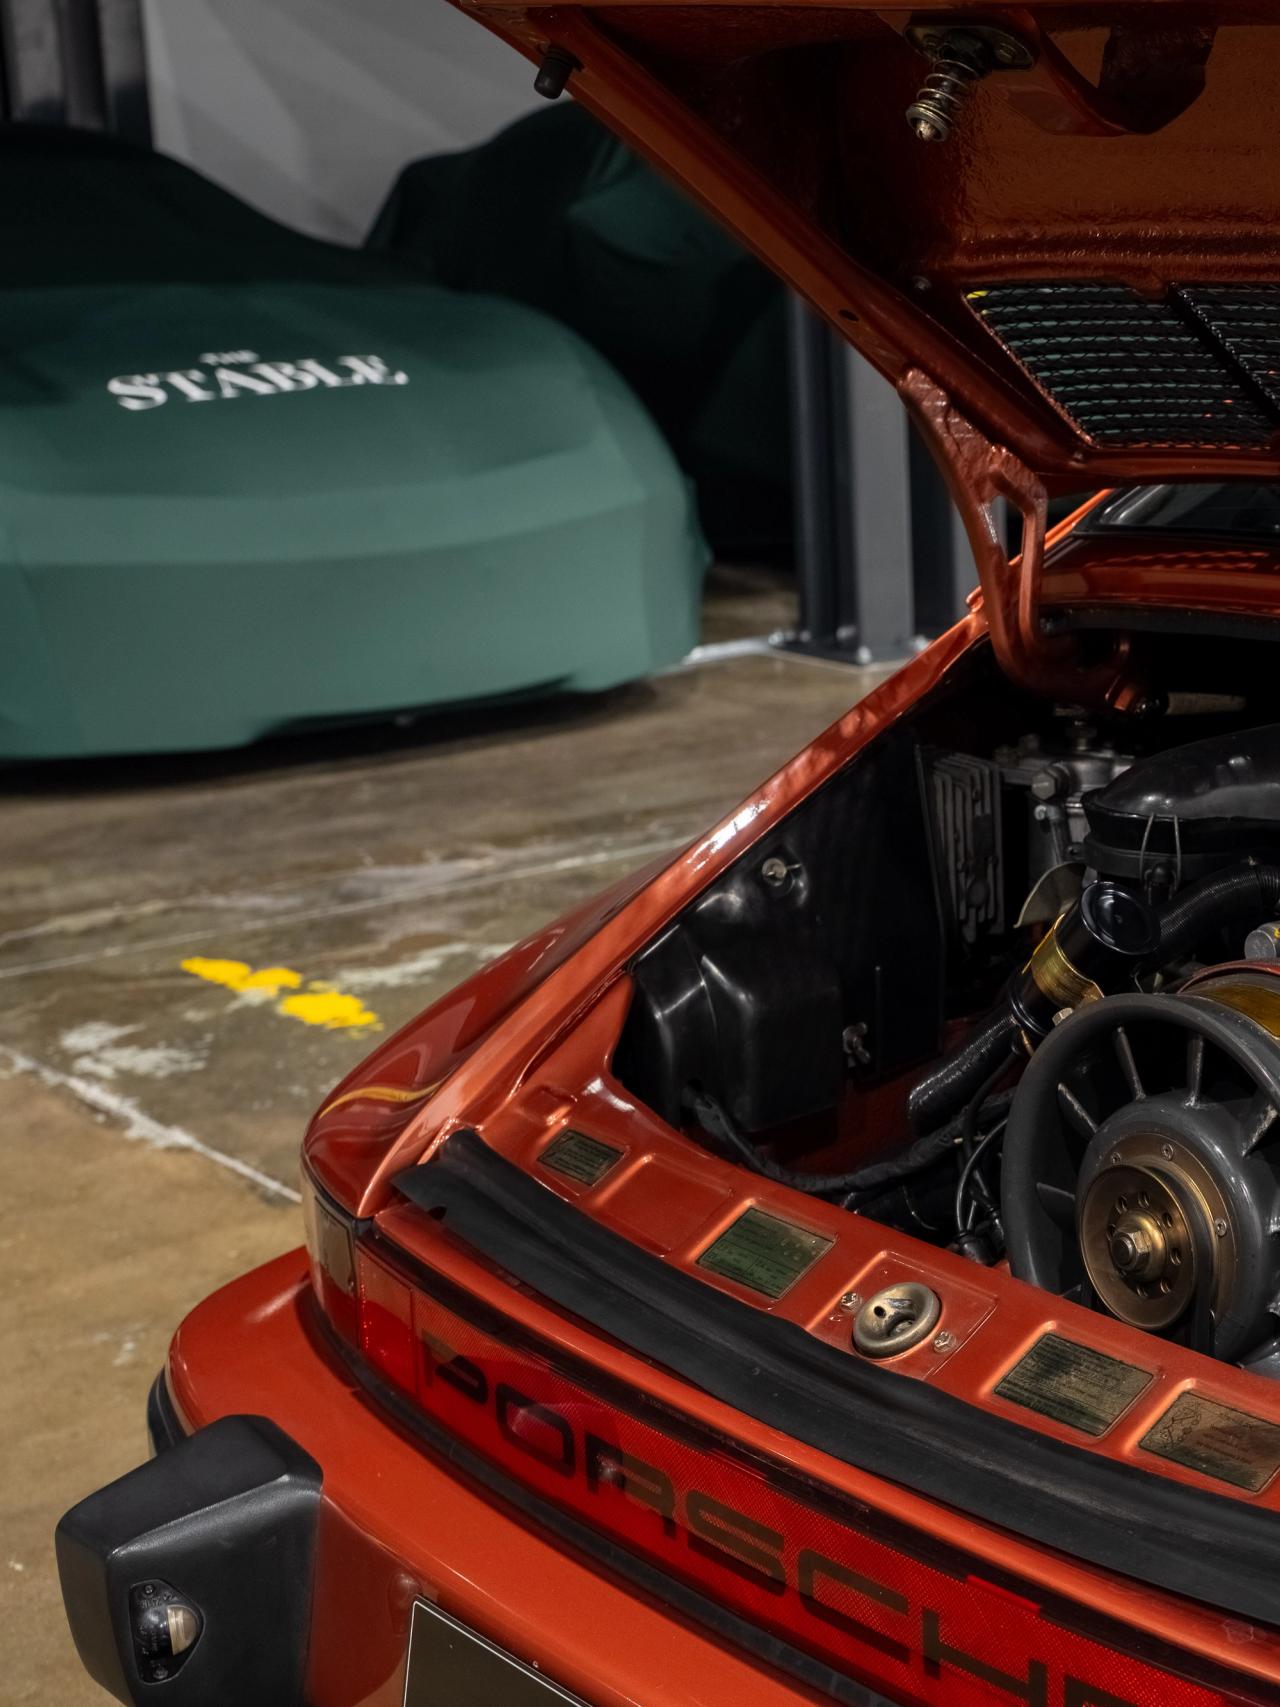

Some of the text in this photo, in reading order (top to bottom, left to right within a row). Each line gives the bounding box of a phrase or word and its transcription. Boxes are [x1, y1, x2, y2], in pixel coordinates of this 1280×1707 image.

[106, 355, 408, 410] STABLE
[199, 350, 260, 366] THE
[421, 1328, 1143, 1707] PORSCH
